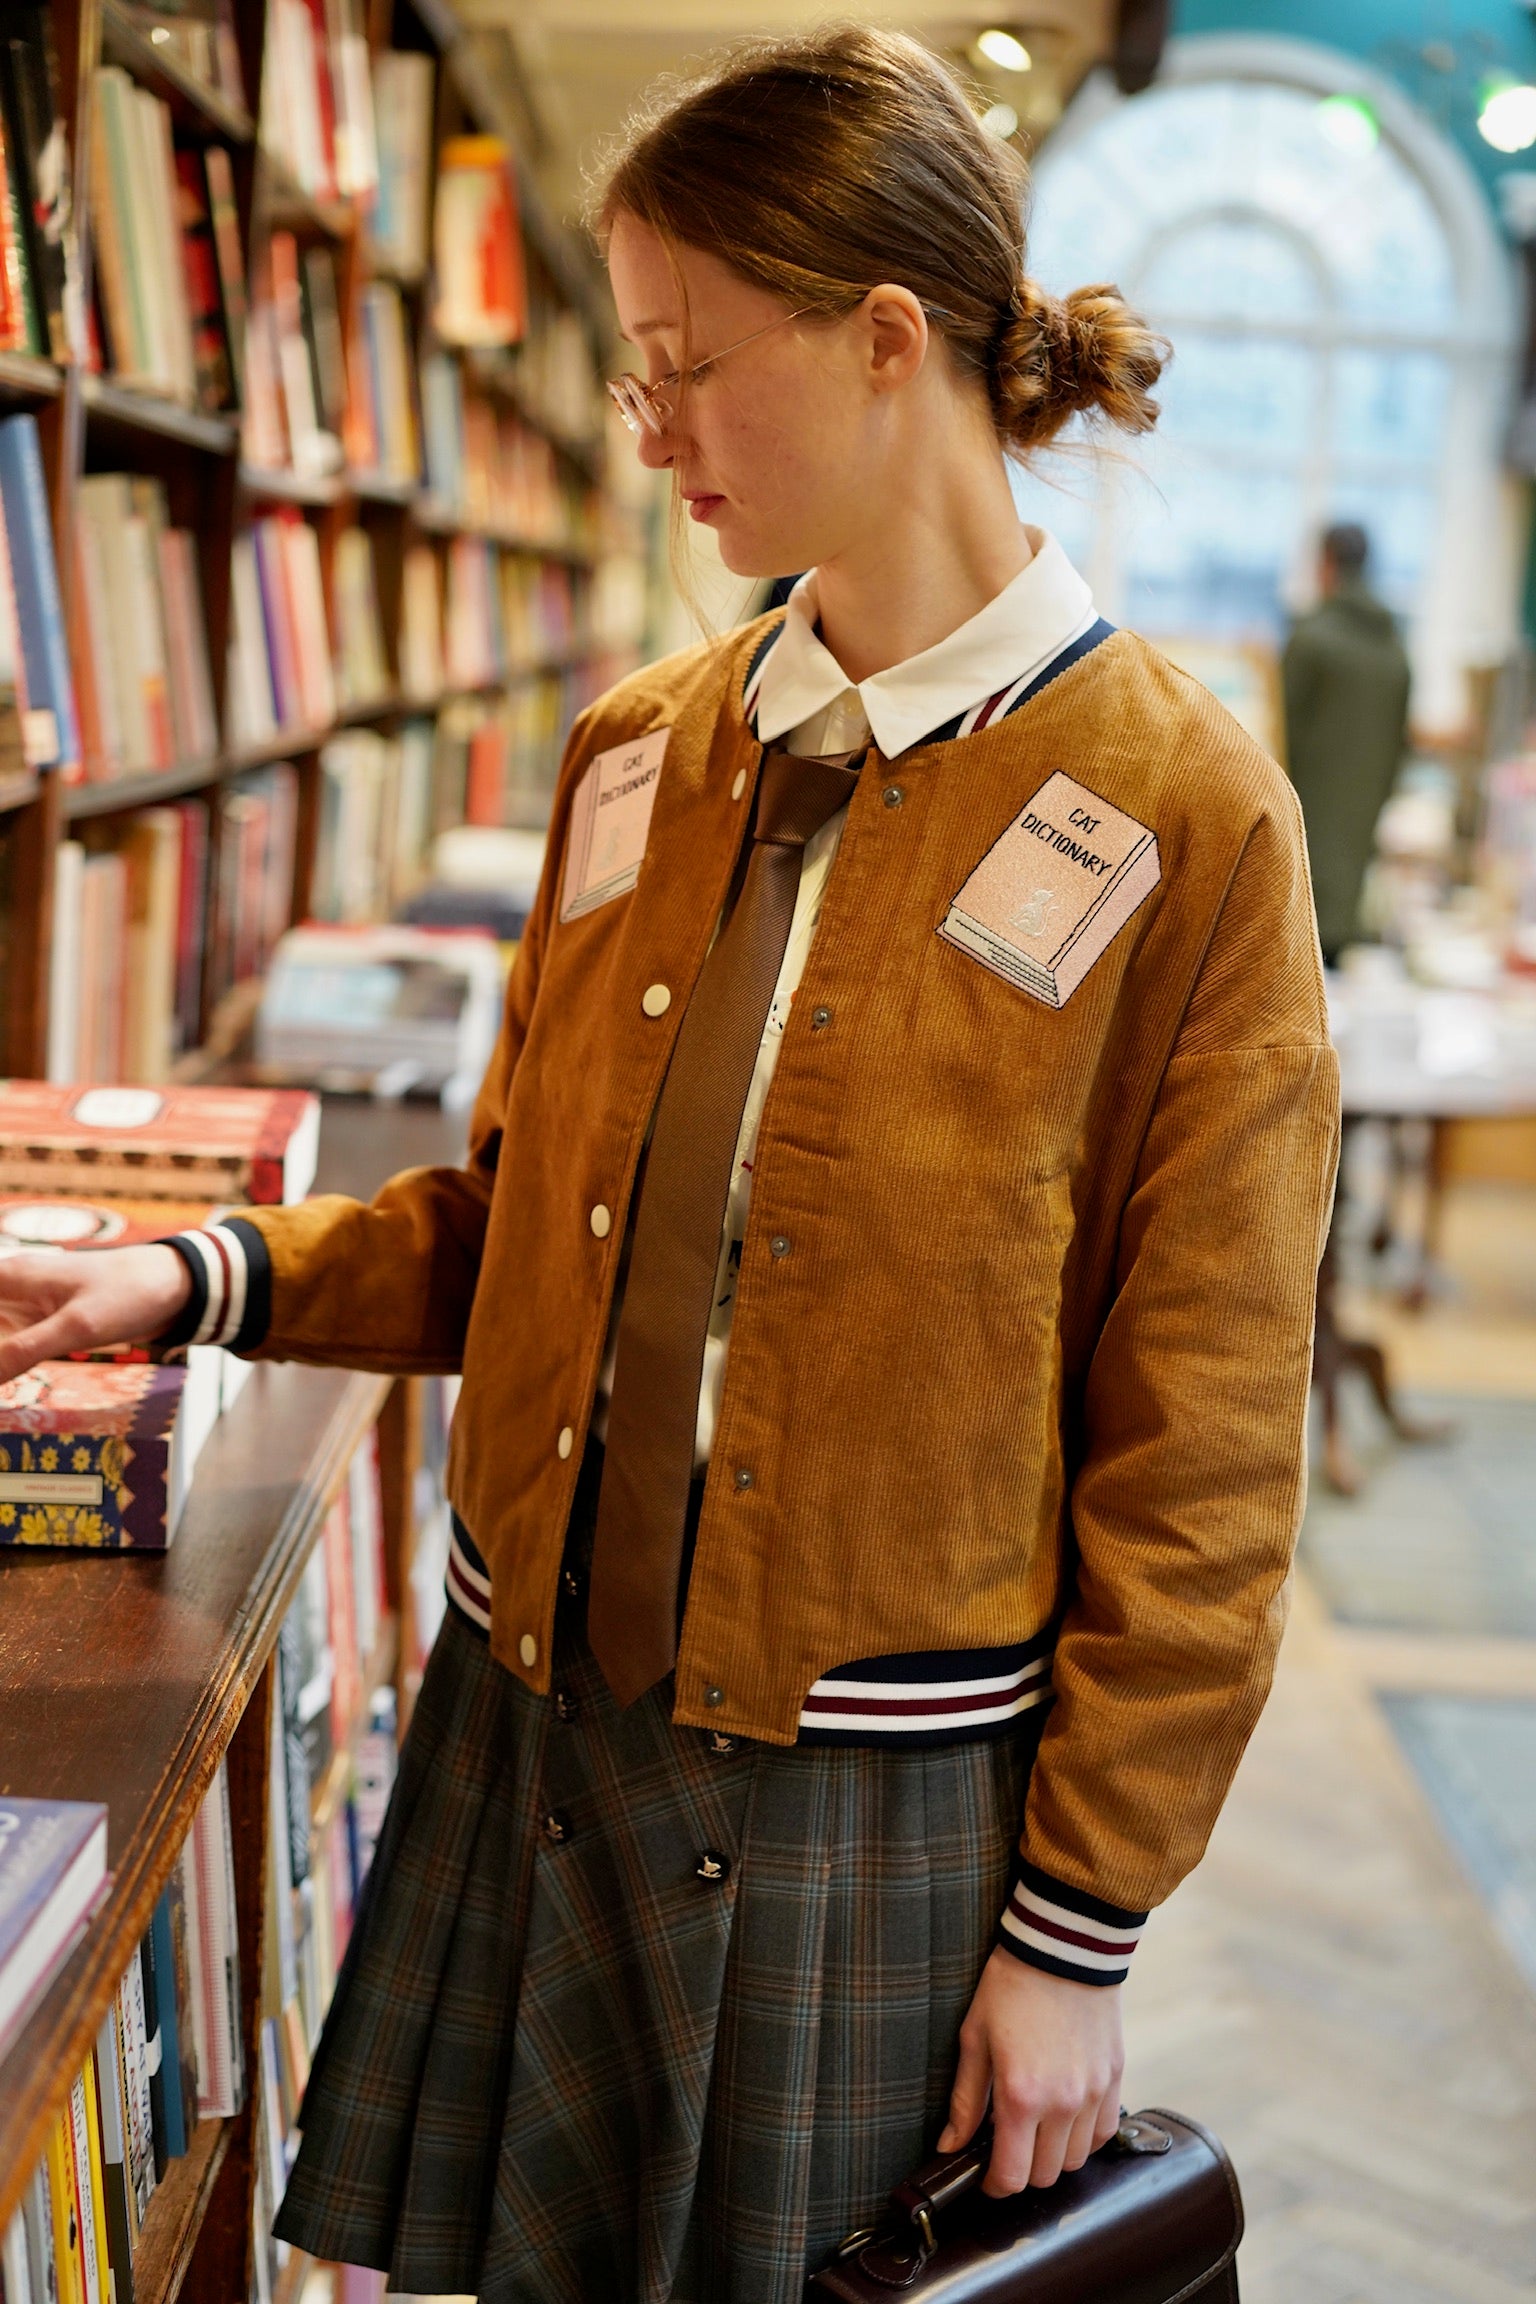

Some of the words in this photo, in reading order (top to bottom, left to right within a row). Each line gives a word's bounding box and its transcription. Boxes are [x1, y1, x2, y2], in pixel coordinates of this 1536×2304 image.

[622, 752, 645, 773] CAT
[599, 764, 661, 807] DICTIONARY
[1067, 807, 1102, 835] CAT
[1020, 812, 1113, 877] DICTIONARY
[124, 2000, 134, 2054] SPY
